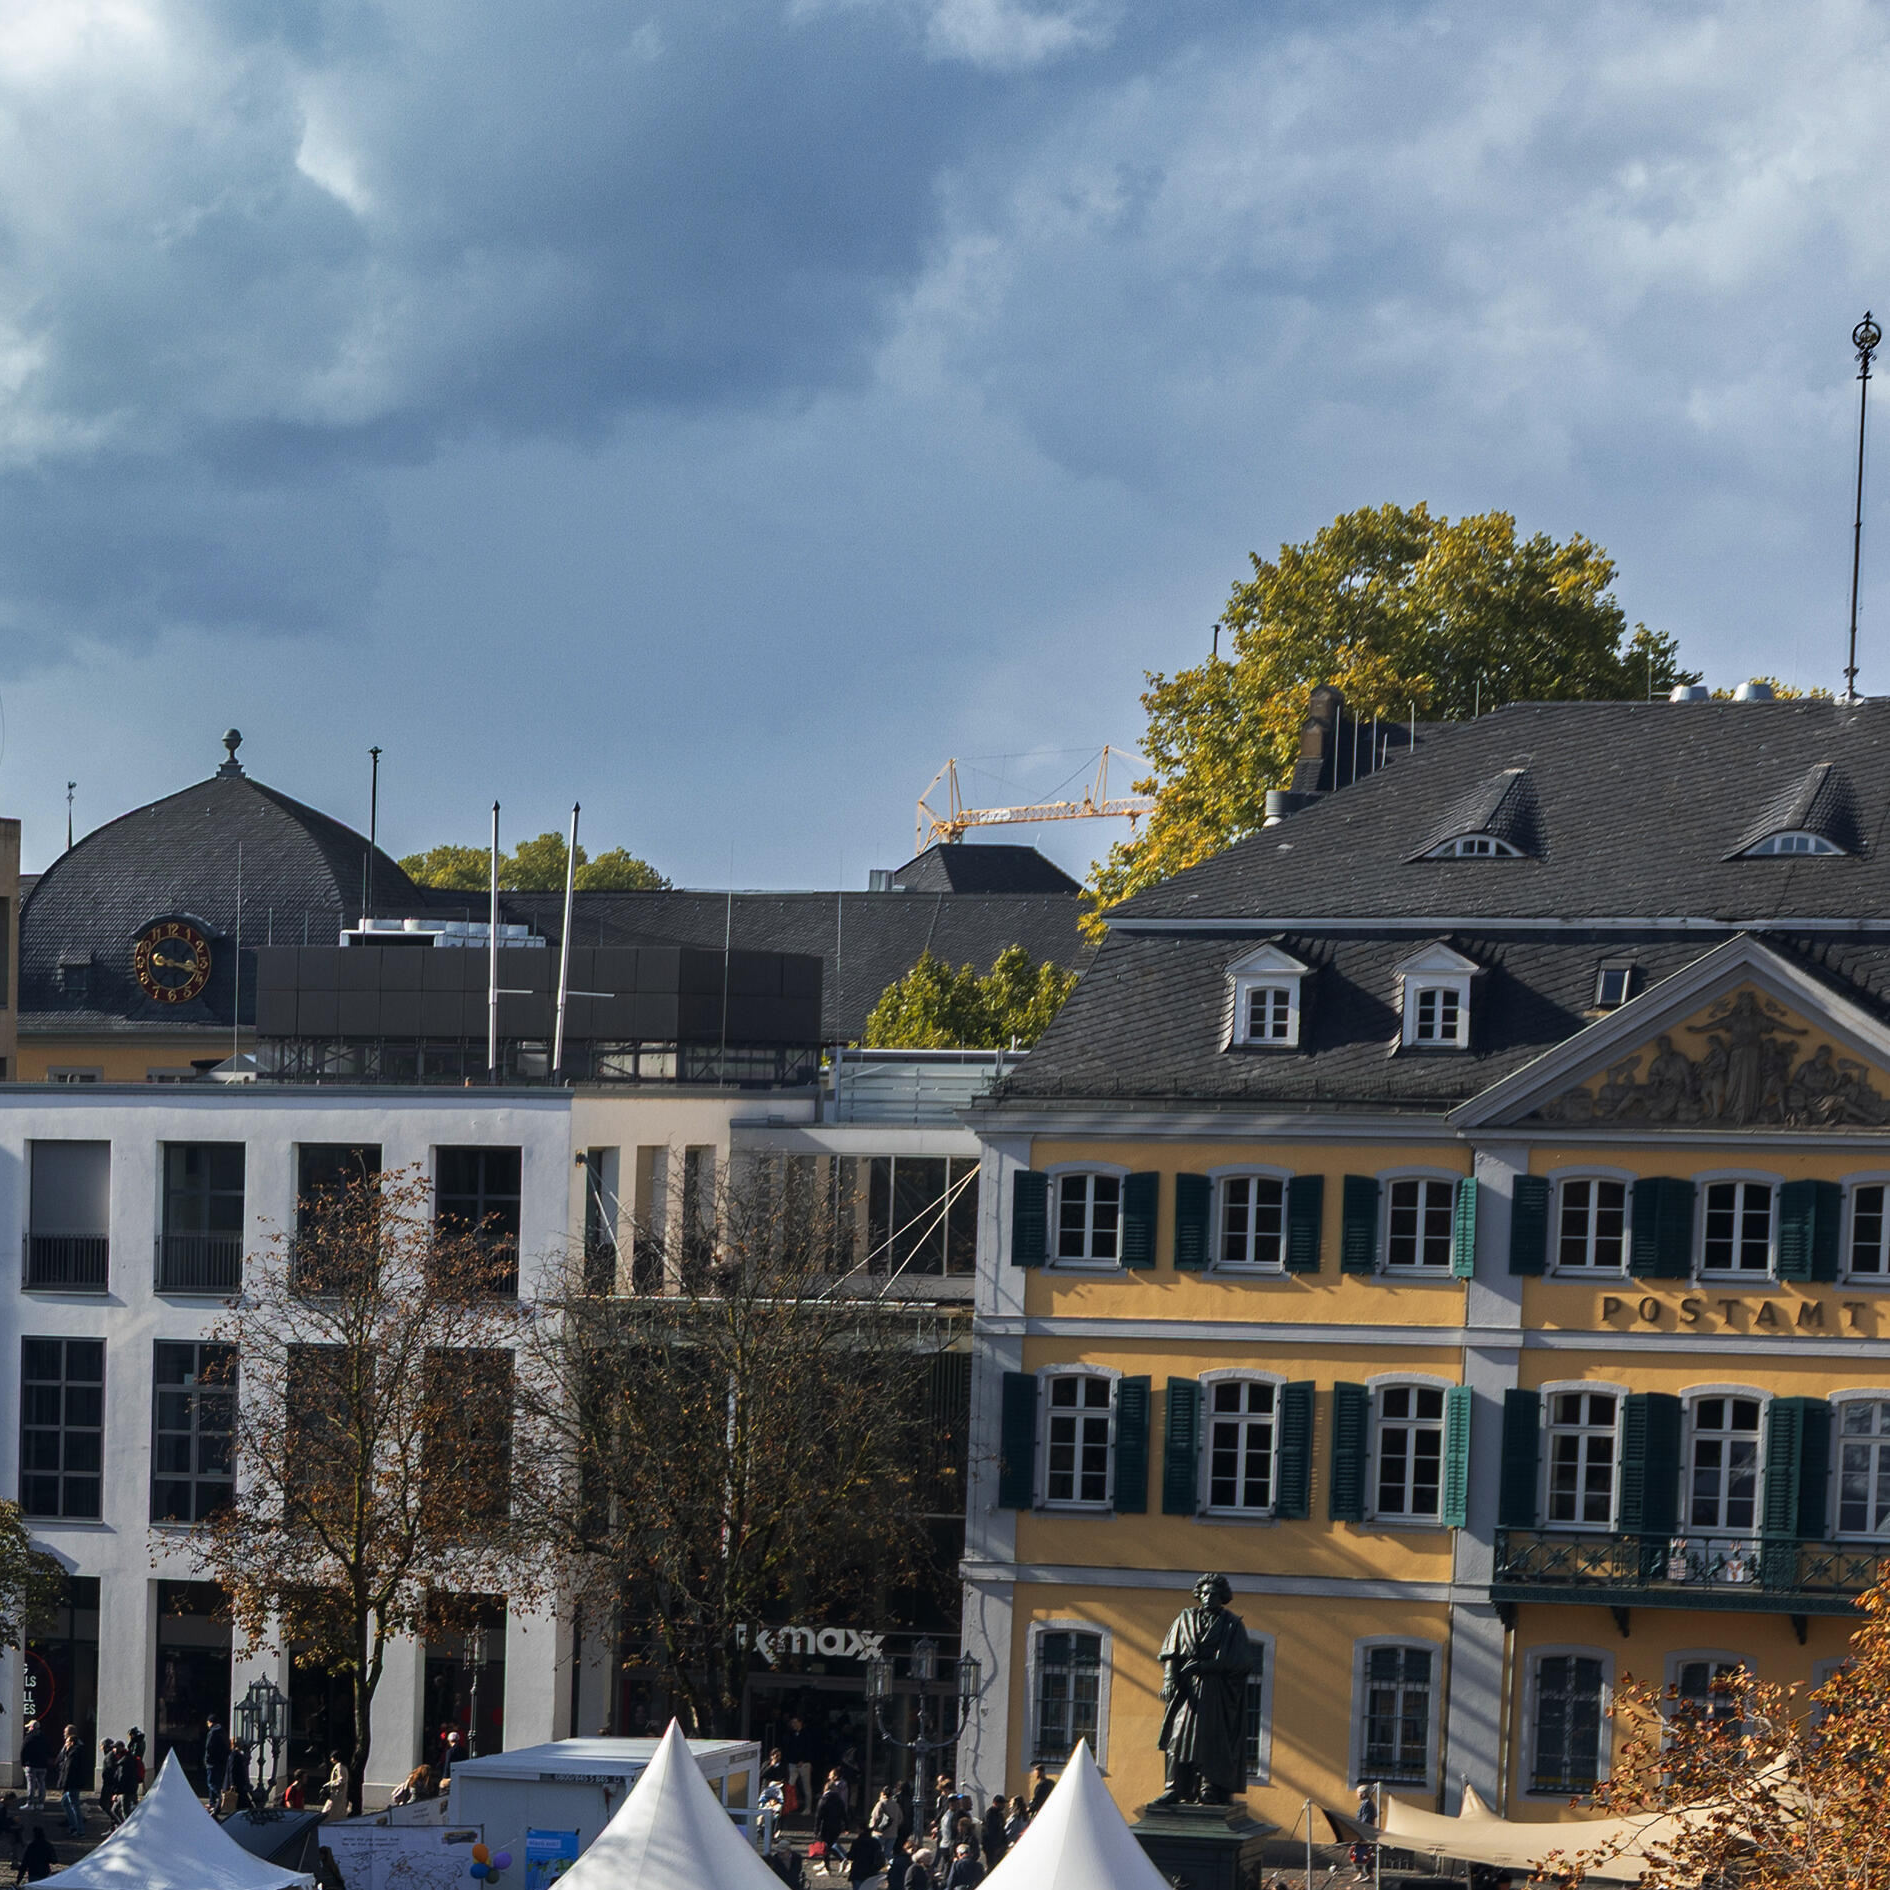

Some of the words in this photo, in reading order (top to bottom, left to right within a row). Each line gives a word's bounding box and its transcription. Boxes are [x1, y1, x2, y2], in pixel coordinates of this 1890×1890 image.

[166, 923, 179, 937] 12
[196, 940, 205, 952] 2
[200, 957, 209, 969] 3
[1601, 1297, 1866, 1328] POSTAMT
